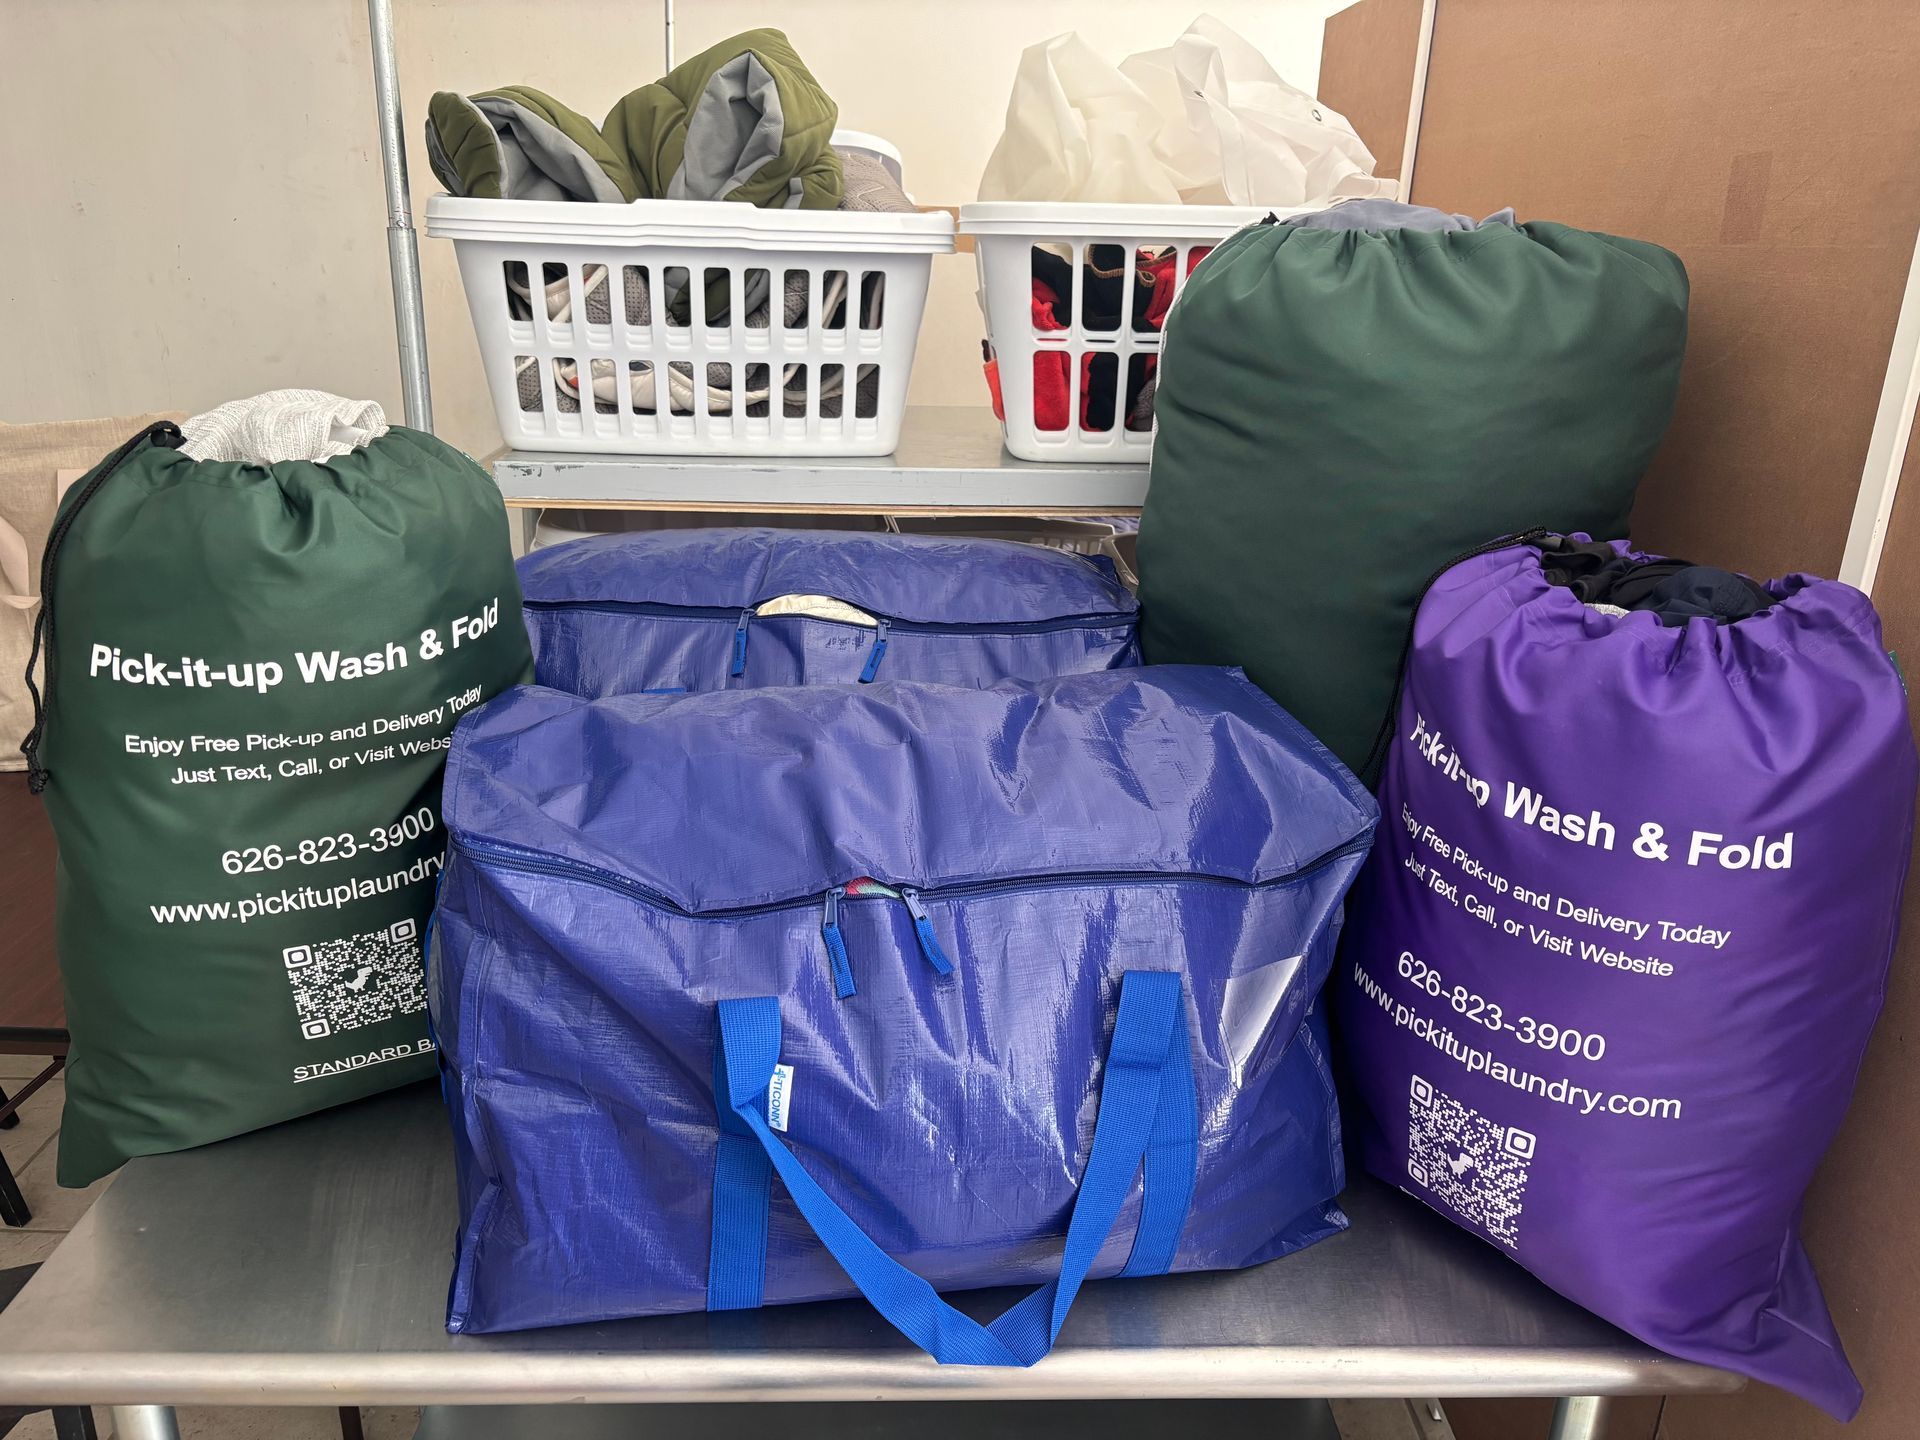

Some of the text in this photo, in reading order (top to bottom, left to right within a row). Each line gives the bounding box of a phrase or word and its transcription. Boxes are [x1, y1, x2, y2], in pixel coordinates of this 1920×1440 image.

[91, 598, 498, 693] Pick-it-up Wash & Fold
[125, 684, 482, 757] Enjoy Free Pick-up and Delivery Today
[171, 731, 453, 784] Just Text, Call, or Visit Webs
[1409, 712, 1793, 869] Pick-it-up Wash & Fold
[150, 851, 445, 923] www.pickituplaundry
[221, 808, 434, 874] 626-823-3900
[1402, 802, 1731, 949] Enjoy Free Pick-up and Delivery Today
[1405, 852, 1674, 977] Just Text, Call, or Visit Website
[1354, 963, 1682, 1120] www.pickituplaundry.com
[1398, 951, 1606, 1061] 626-823-3900
[293, 1044, 411, 1083] STANDARD
